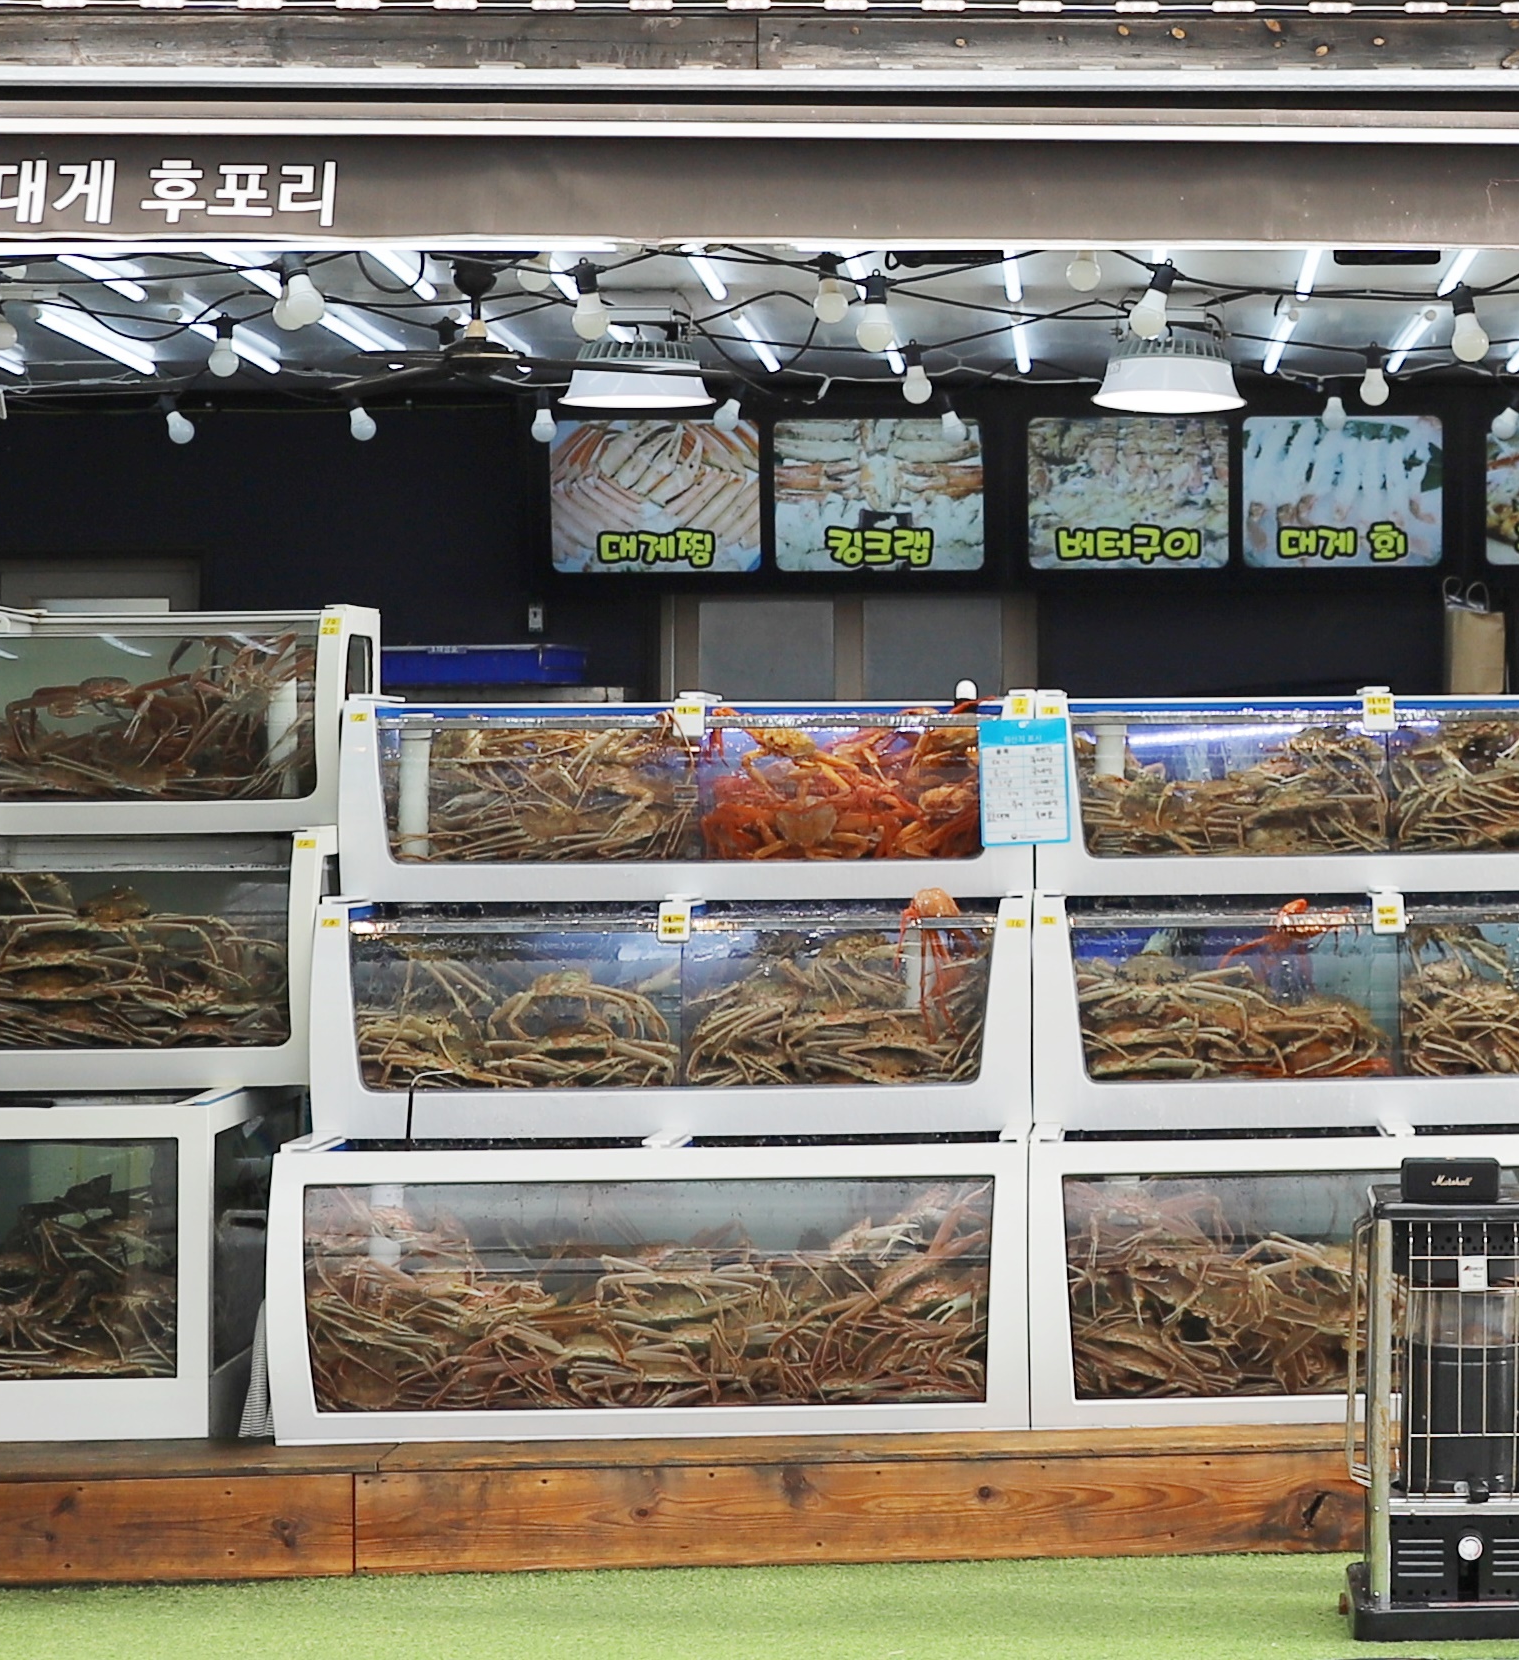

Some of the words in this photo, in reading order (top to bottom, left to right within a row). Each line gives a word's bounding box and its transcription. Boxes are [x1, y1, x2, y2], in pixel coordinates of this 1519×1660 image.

[138, 158, 338, 229] 후포리
[598, 530, 714, 566] 대게찜
[826, 527, 935, 566] 킹크랩
[1057, 524, 1202, 562] 버터구이
[1278, 527, 1357, 561] 대게
[1369, 522, 1409, 562] 회
[1431, 1174, 1473, 1187] Marshall
